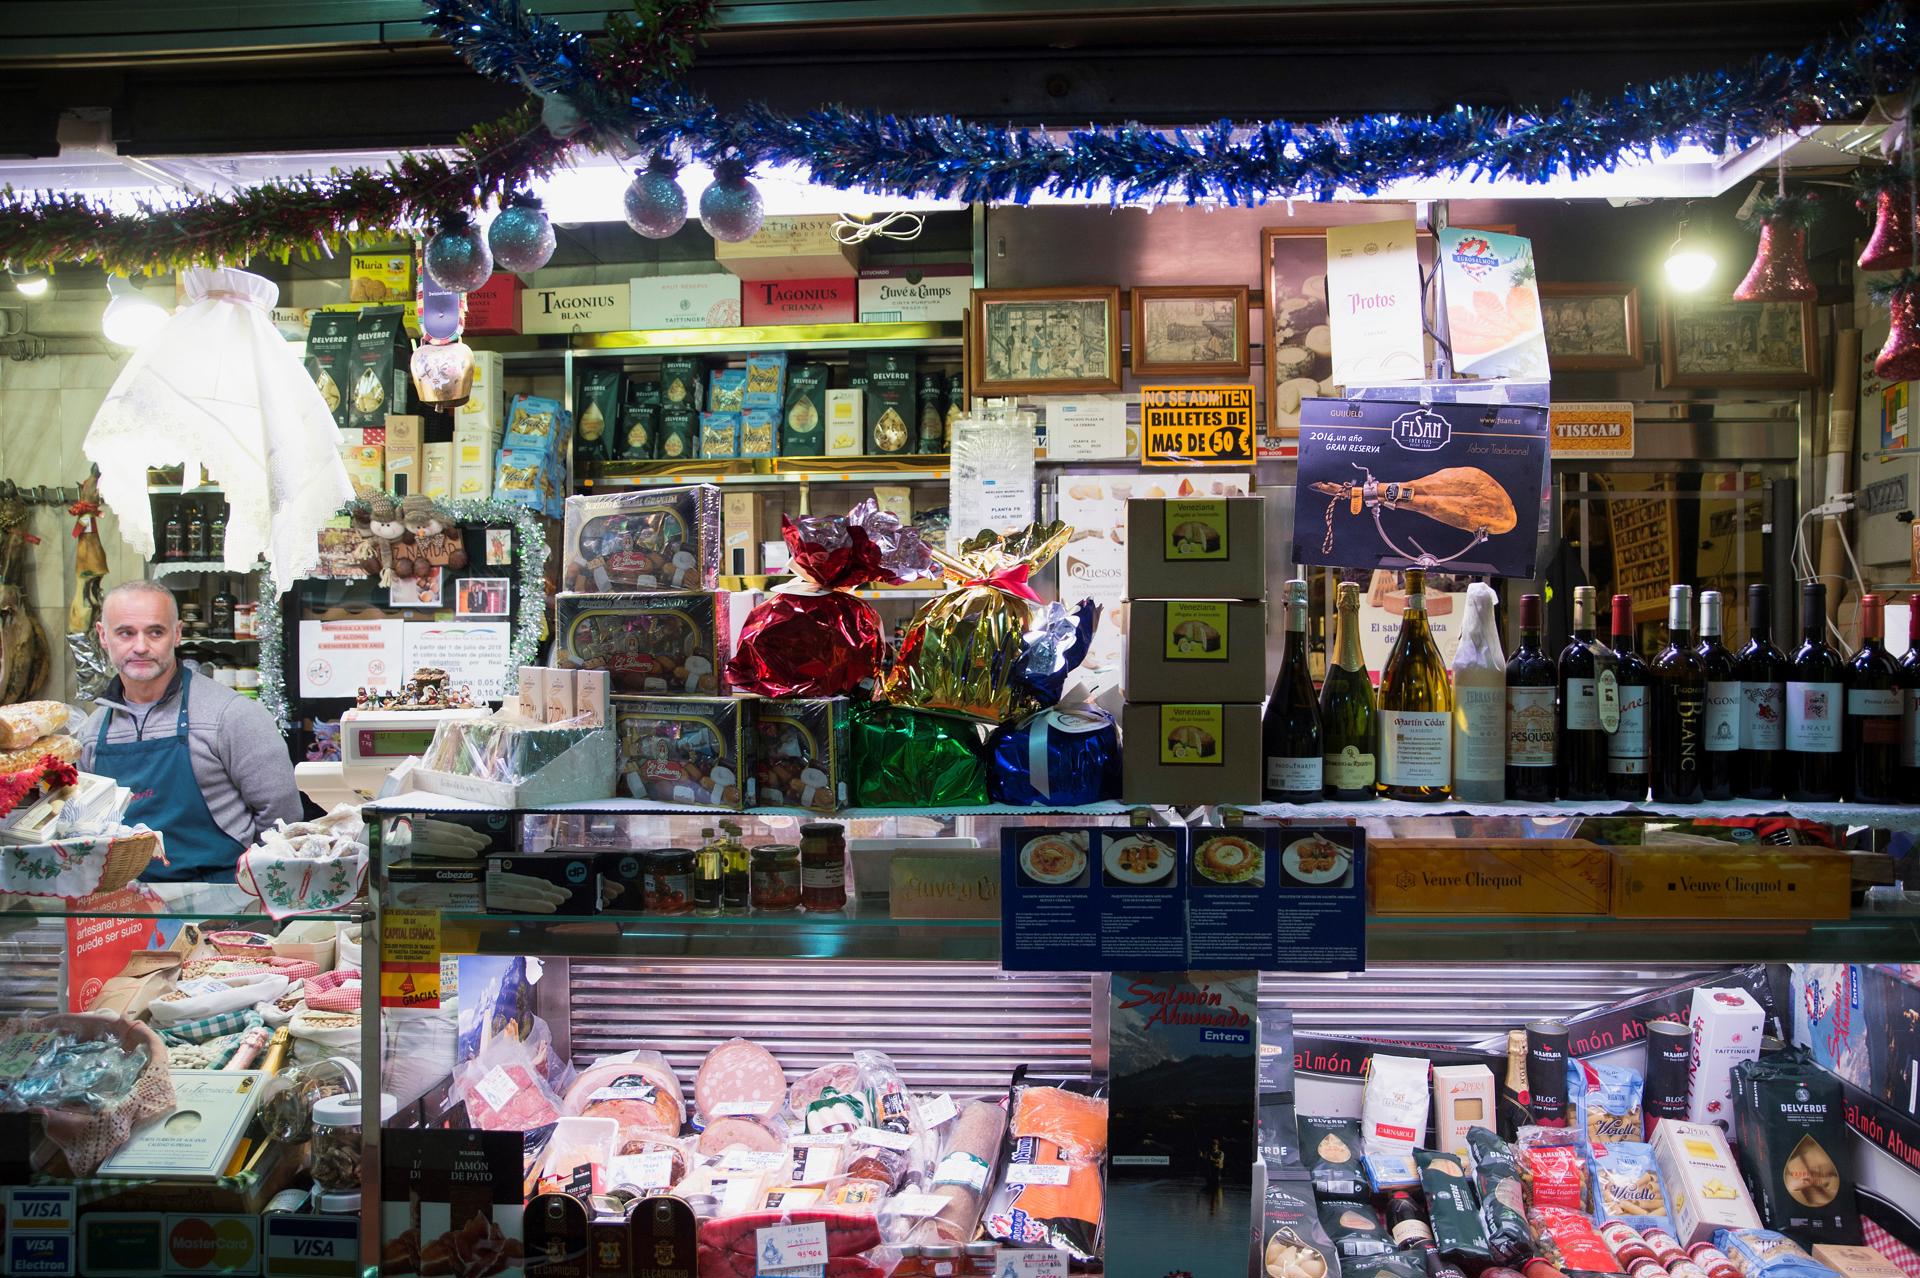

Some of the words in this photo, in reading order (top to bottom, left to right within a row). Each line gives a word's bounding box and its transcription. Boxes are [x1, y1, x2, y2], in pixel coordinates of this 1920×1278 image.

[353, 259, 383, 271] Nuria
[1456, 255, 1496, 266] EUROSALMON
[760, 283, 838, 306] TAGONIUS
[880, 284, 909, 300] Juvé
[918, 283, 952, 299] Camps
[538, 291, 615, 314] TAGONIUS
[781, 302, 824, 311] CRIANZA
[1346, 292, 1396, 315] Protos
[270, 309, 300, 322] Nuria
[561, 311, 592, 320] BLANC
[312, 335, 349, 344] DELVERDE
[357, 330, 390, 341] DELVERDE
[873, 372, 910, 380] DELVERDE
[1145, 391, 1166, 407] NO
[1168, 391, 1189, 407] SE
[1191, 390, 1249, 407] ADMITEN
[1151, 411, 1222, 426] BILLETES
[1227, 411, 1247, 425] DE
[1330, 409, 1364, 418] GUIJUELO
[1401, 415, 1442, 439] FISAN
[1479, 417, 1521, 426] www.fisan.es
[1556, 423, 1621, 437] TISECAM
[1152, 433, 1182, 453] MAS
[1187, 433, 1206, 452] DE
[1212, 431, 1233, 453] 50
[1239, 434, 1250, 452] €
[1348, 434, 1363, 442] año
[1325, 443, 1347, 452] GRAN
[1349, 444, 1380, 454] RESERVA
[1467, 442, 1489, 455] Sabor
[1490, 443, 1530, 456] Tradicional
[1177, 503, 1215, 511] Veneziana
[406, 544, 457, 559] NAVIDAD
[1072, 563, 1122, 581] Quesos
[1179, 603, 1216, 611] Veneziana
[1371, 623, 1380, 632] El
[463, 644, 476, 652] julio
[1173, 707, 1211, 716] Veneziana
[1394, 718, 1422, 729] Martín
[1424, 718, 1446, 727] Códax
[1676, 700, 1703, 772] BLANC
[436, 870, 473, 879] Cabezón
[569, 865, 585, 879] dp
[621, 861, 636, 875] dp
[1422, 870, 1462, 888] Veuve
[1465, 870, 1523, 889] Clicquot
[1680, 876, 1721, 893] Veuve
[1724, 875, 1783, 895] Clicquot
[76, 917, 115, 940] artesanal
[384, 927, 407, 940] CAPITAL
[409, 924, 435, 940] ESPAÑOL
[76, 936, 104, 957] puede
[105, 930, 119, 943] ser
[121, 922, 143, 937] suizo
[402, 989, 438, 1006] GRACIAS
[1118, 979, 1222, 1009] Salmón
[1144, 1005, 1250, 1030] Ahumado
[1204, 1030, 1245, 1042] Entero
[1568, 1029, 1620, 1056] lmón
[1293, 1050, 1352, 1073] almón
[1535, 1095, 1557, 1103] BLOC
[1780, 1103, 1828, 1113] DELVERDE
[1308, 1117, 1348, 1125] DELVERDE
[1595, 1119, 1637, 1136] Voiello
[1377, 1128, 1414, 1138] CARNAROLI
[1842, 1098, 1884, 1145] Salmón
[1887, 1129, 1920, 1167] Ahum
[455, 1160, 489, 1170] JAMÓN
[451, 1172, 465, 1180] DE
[466, 1172, 493, 1181] PATO
[579, 1182, 591, 1192] GRAS
[1610, 1184, 1656, 1201] Voiello
[21, 1203, 62, 1217] VISA
[25, 1239, 54, 1250] VISA
[172, 1236, 248, 1250] MasterCard
[292, 1240, 335, 1256] VISA
[15, 1259, 65, 1271] Electron
